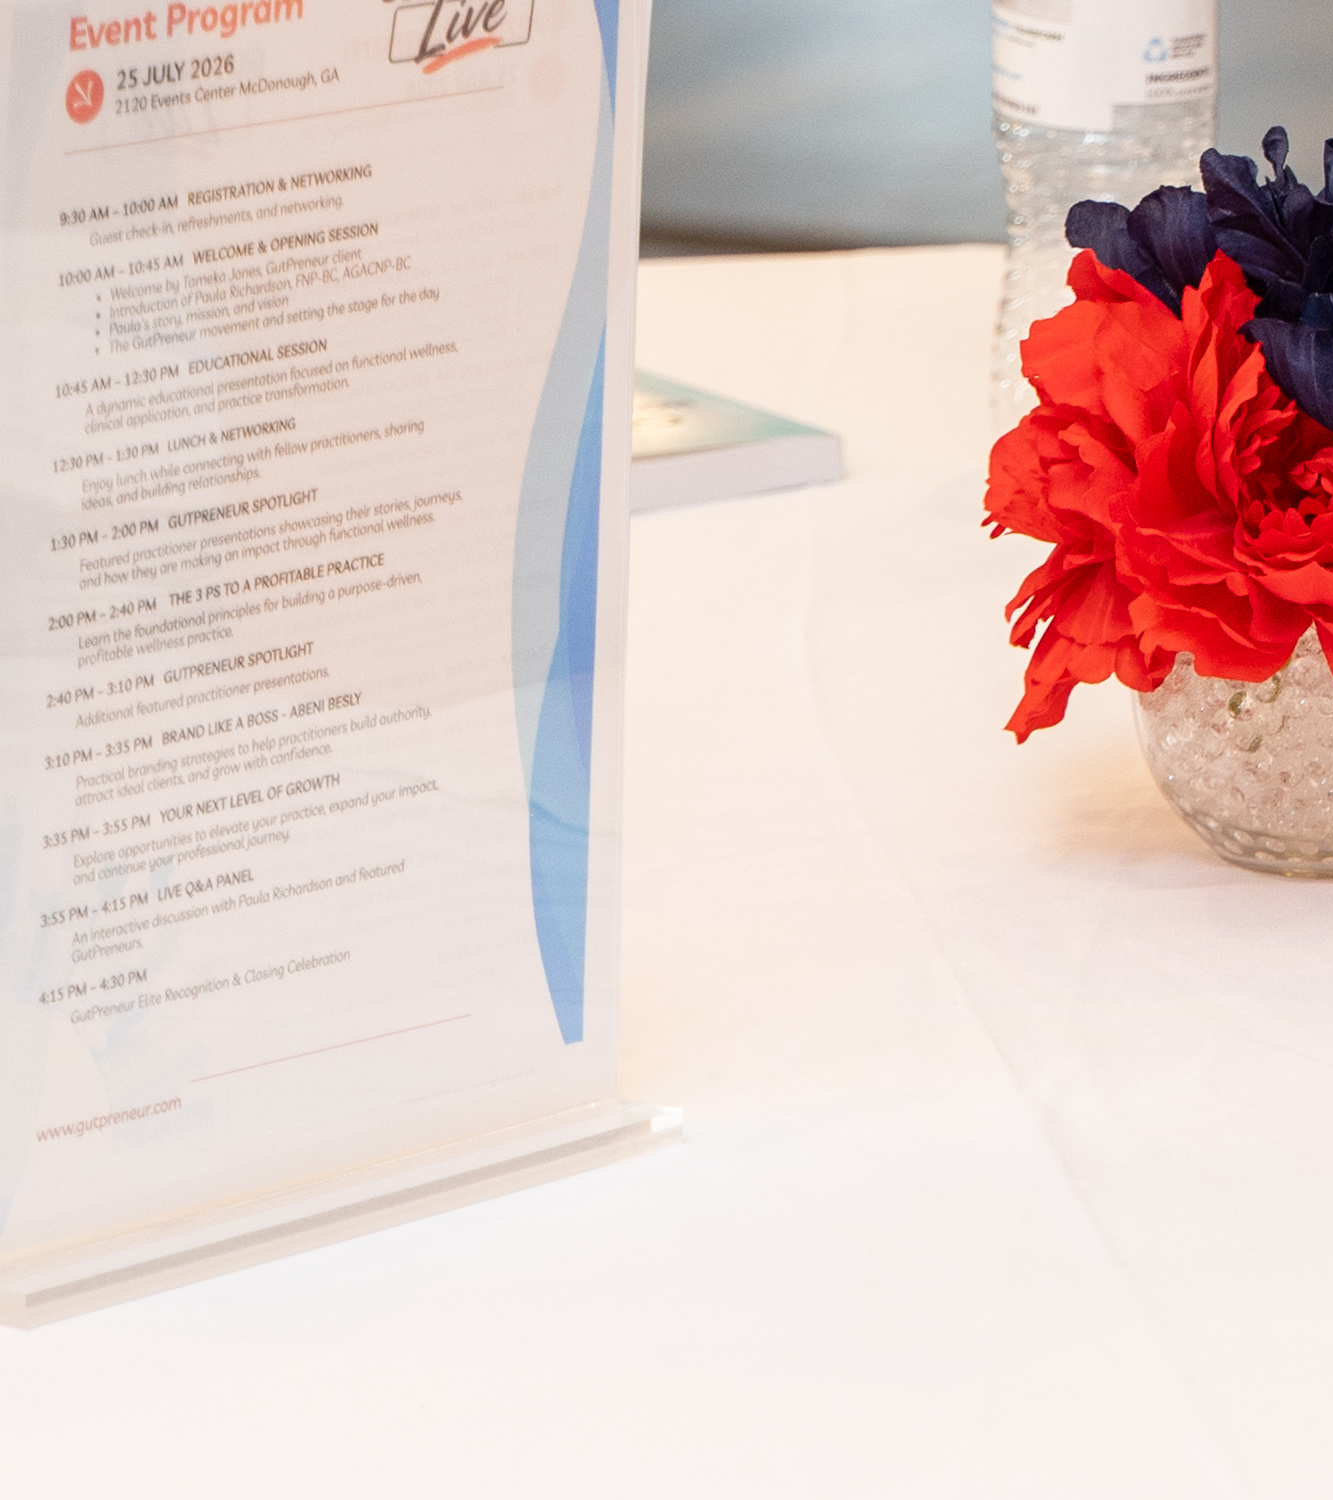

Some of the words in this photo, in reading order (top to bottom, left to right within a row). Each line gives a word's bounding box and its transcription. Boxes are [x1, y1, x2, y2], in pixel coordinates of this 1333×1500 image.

[69, 10, 157, 51] Event
[115, 95, 148, 115] 2120
[150, 91, 192, 110] Events
[194, 86, 236, 103] Center
[238, 72, 318, 96] McDonough,
[320, 67, 340, 84] GA
[116, 69, 138, 91] 25
[143, 62, 186, 87] JULY
[191, 54, 235, 80] 2026
[60, 209, 86, 226] 9:30
[89, 206, 109, 221] AM
[123, 198, 155, 216] 10:00
[158, 195, 178, 210] AM
[188, 180, 274, 206] REGISTRATION
[278, 178, 287, 191] &
[291, 164, 372, 189] NETWORKING
[89, 231, 123, 247] Guest
[125, 221, 175, 241] check-in,
[177, 208, 253, 232] refreshments,
[256, 203, 278, 220] and
[280, 195, 344, 215] networking.
[59, 269, 91, 287] 10:00
[95, 265, 115, 280] AM
[129, 258, 160, 275] 10:45
[164, 254, 183, 269] AM
[192, 242, 254, 264] WELCOME
[258, 240, 267, 254] &
[270, 230, 325, 252] OPENING
[328, 222, 378, 242] SESSION
[110, 284, 162, 301] Welcome
[165, 278, 180, 295] by
[183, 270, 226, 288] Tameka
[228, 263, 263, 281] Jones,
[266, 254, 330, 275] GutPreneur
[332, 248, 362, 264] client
[109, 299, 178, 319] Introduction
[180, 293, 194, 307] of
[194, 287, 227, 305] Paula
[229, 278, 293, 299] Richardson,
[56, 380, 87, 398] 10:45
[91, 377, 111, 391] AM
[125, 368, 157, 386] 12:30
[160, 364, 179, 380] PM
[189, 348, 274, 375] EDUCATIONAL
[277, 339, 327, 359] SESSION
[53, 456, 83, 473] 12:30
[86, 452, 104, 467] PM
[116, 446, 139, 461] 1:30
[141, 443, 159, 456] PM
[167, 435, 206, 452] LUNCH
[209, 432, 217, 444] &
[221, 417, 296, 442] NETWORKING
[51, 534, 76, 551] 1:30
[79, 530, 98, 546] PM
[112, 522, 137, 540] 2:00
[140, 518, 159, 534] PM
[168, 501, 250, 529] GUTPRENEUR
[252, 488, 318, 513] SPOTLIGHT
[48, 613, 74, 631] 2:00
[77, 610, 96, 625] PM
[110, 602, 134, 619] 2:40
[138, 597, 157, 613] PM
[169, 590, 192, 606] THE
[196, 588, 202, 602] 3
[224, 581, 240, 596] TO
[243, 579, 251, 592] A
[254, 564, 324, 590] PROFITABLE
[327, 553, 384, 576] PRACTICE
[47, 691, 72, 708] 2:40
[75, 686, 94, 702] PM
[107, 678, 132, 695] 3:10
[135, 674, 154, 689] PM
[163, 655, 245, 684] GUTPRENEUR
[248, 641, 314, 667] SPOTLIGHT
[45, 752, 70, 770] 3:10
[73, 748, 92, 764] PM
[106, 740, 130, 757] 3:35
[134, 735, 152, 751] PM
[162, 724, 205, 745] BRAND
[208, 718, 232, 736] LIKE
[236, 717, 244, 729] A
[247, 709, 278, 728] BOSS
[290, 699, 325, 718] ABENI
[328, 691, 362, 711] BESLY
[43, 831, 67, 849] 3:35
[71, 826, 90, 843] PM
[103, 818, 128, 836] 3:55
[131, 814, 151, 829] PM
[160, 804, 193, 823] YOUR
[196, 797, 227, 815] NEXT
[230, 790, 264, 809] LEVEL
[267, 785, 283, 800] OF
[285, 773, 340, 796] GROWTH
[41, 910, 65, 928] 3:55
[69, 905, 88, 921] PM
[101, 897, 126, 913] 4:15
[130, 892, 148, 908] PM
[158, 884, 182, 902] LIVE
[185, 878, 213, 898] Q&A
[216, 869, 254, 888] PANEL
[39, 987, 64, 1004] 4:15
[67, 982, 87, 998] PM
[100, 973, 125, 991] 4:30
[128, 969, 147, 985] PM
[70, 1000, 134, 1024] GutPreneur
[138, 993, 162, 1009] Elite
[164, 977, 230, 1002] Recognition
[232, 973, 241, 987] &
[244, 965, 285, 984] Closing
[287, 951, 350, 974] Celebration
[36, 1098, 182, 1142] www.gutpreneur.com
